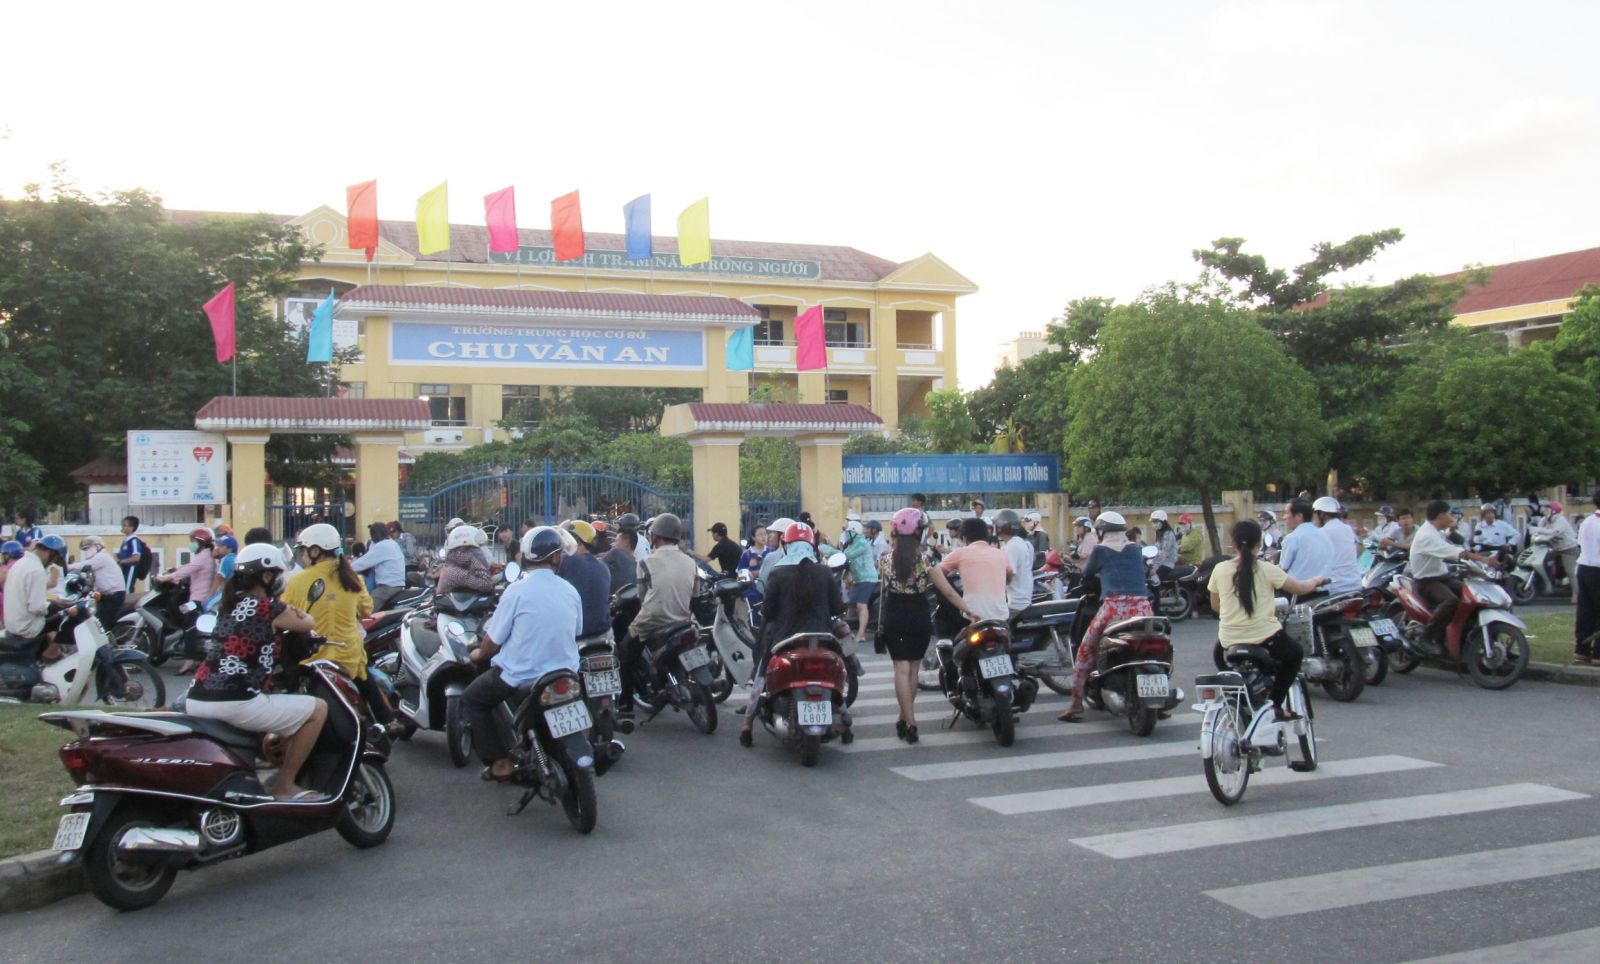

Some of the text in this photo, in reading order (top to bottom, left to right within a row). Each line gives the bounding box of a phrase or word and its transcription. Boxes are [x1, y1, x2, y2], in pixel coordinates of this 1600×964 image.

[452, 325, 513, 337] TRƯỜNG
[515, 328, 566, 338] TRUNG
[570, 330, 604, 341] HỌC
[428, 339, 670, 362] CHU VĂN AN
[1004, 465, 1022, 481] GIAO
[1023, 462, 1049, 481] THÔNG
[551, 704, 580, 721] 75-F1
[553, 715, 588, 736] 162.17
